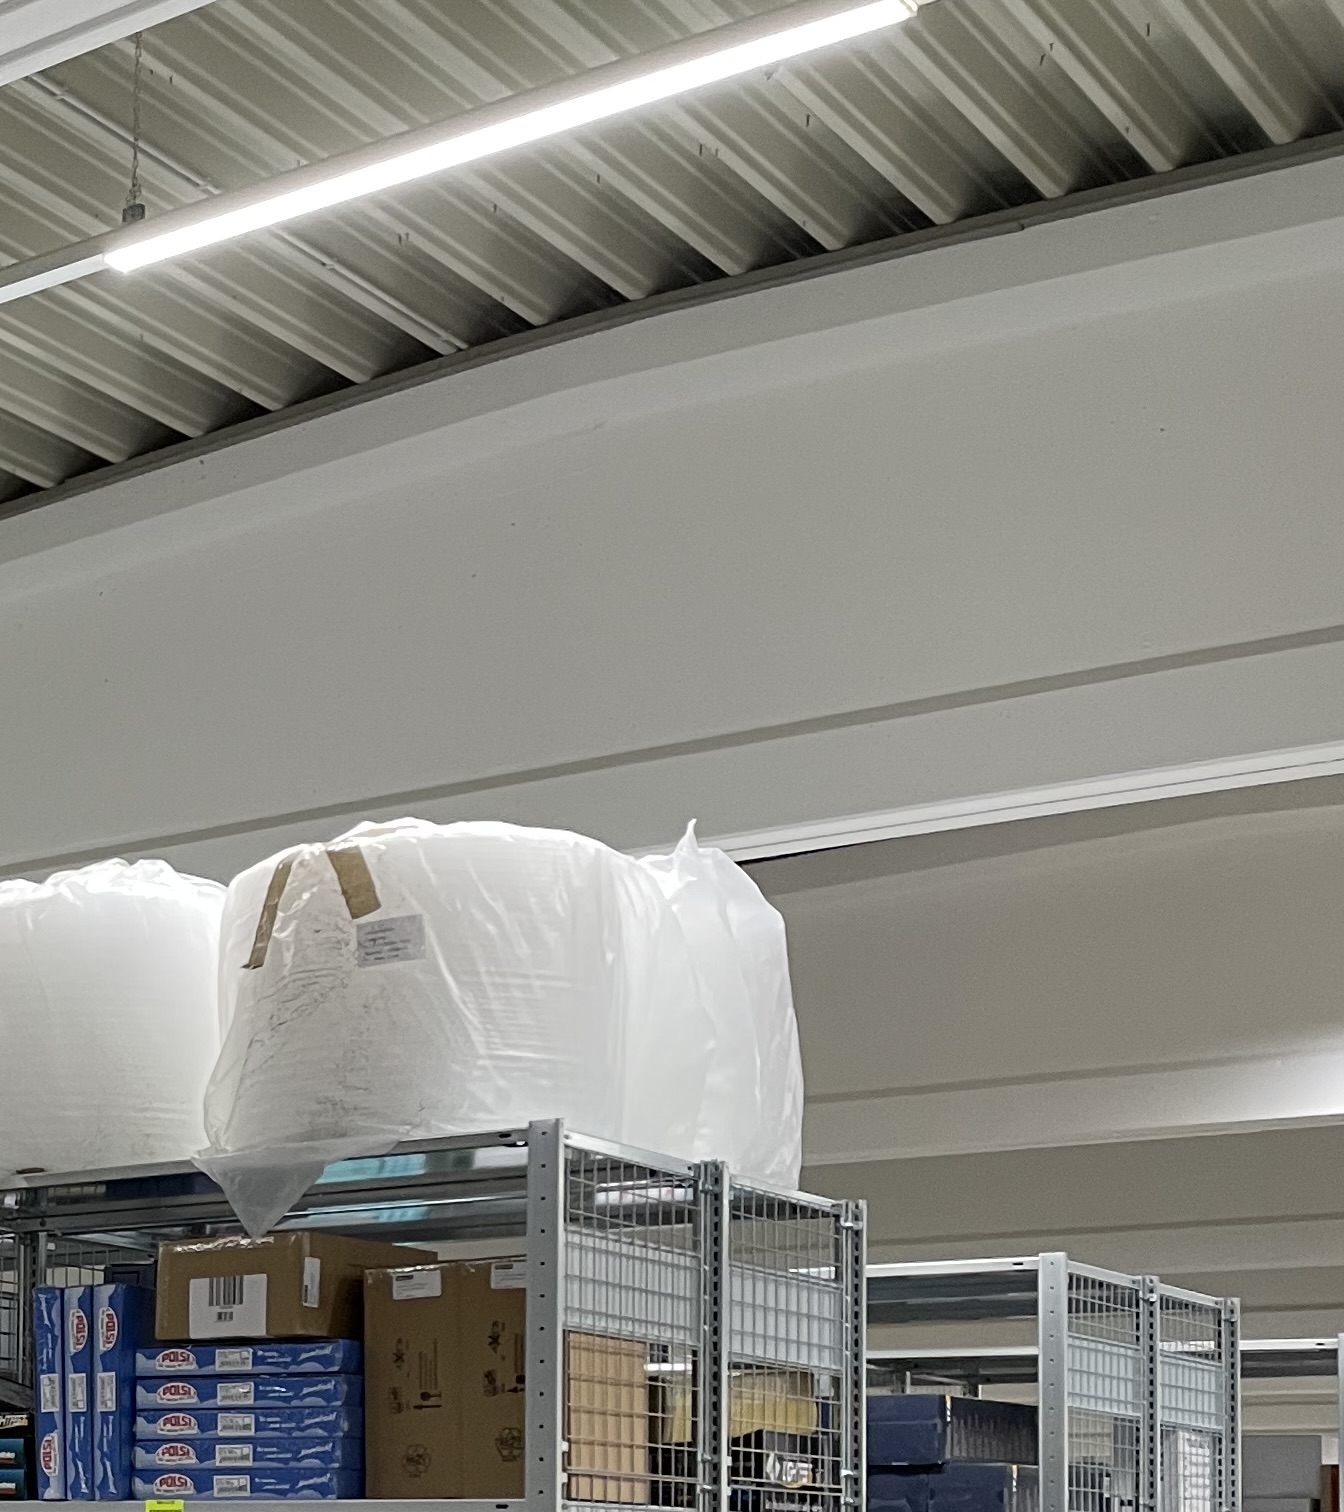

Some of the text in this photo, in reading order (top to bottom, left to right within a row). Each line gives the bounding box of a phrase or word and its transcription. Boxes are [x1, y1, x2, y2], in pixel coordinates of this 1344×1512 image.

[161, 1350, 191, 1363] POLSI
[162, 1385, 192, 1396] POLSI
[162, 1415, 192, 1427] POLSI
[161, 1446, 191, 1457] POLSI
[159, 1477, 188, 1488] POLSI
